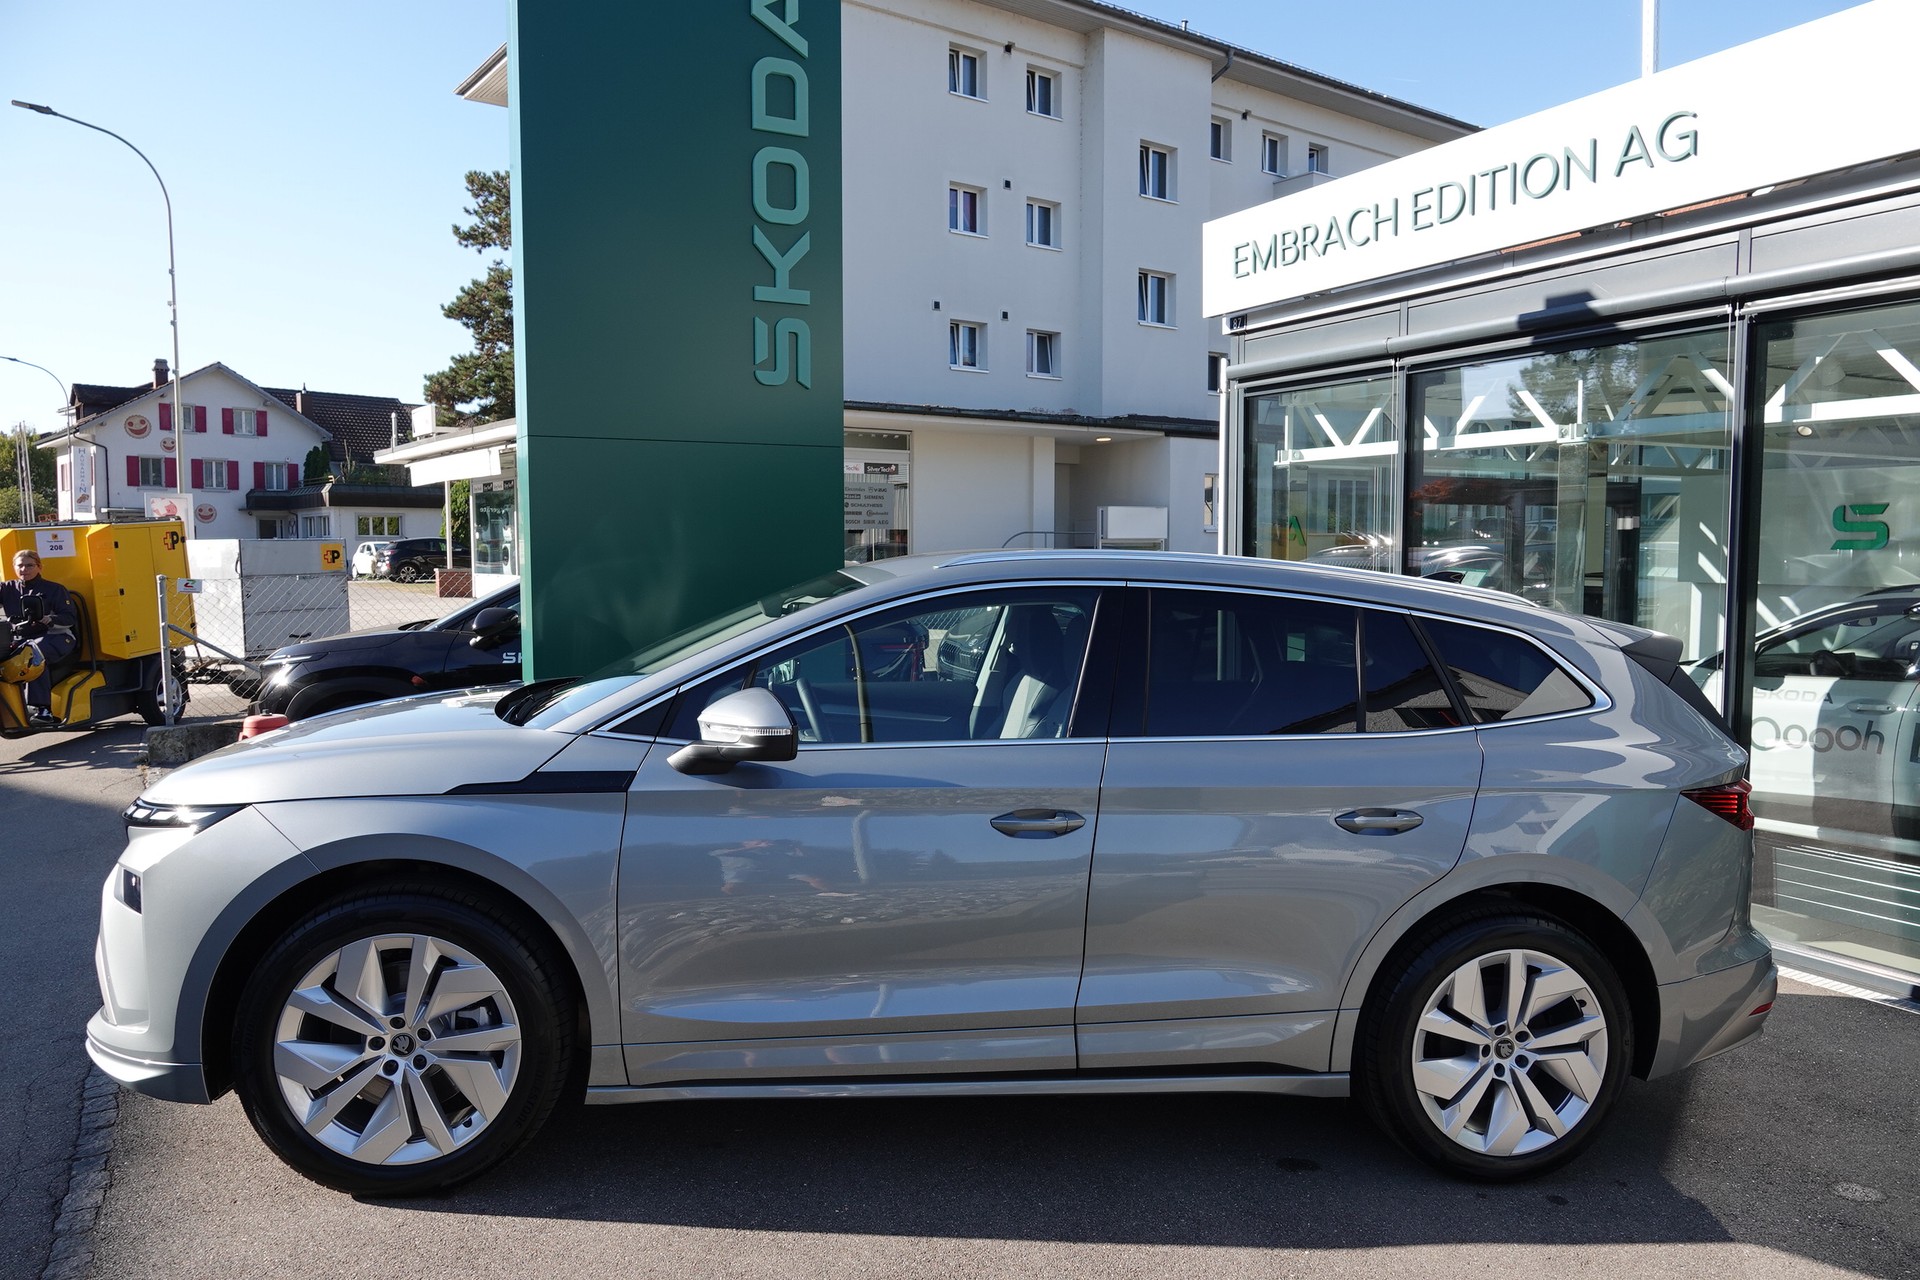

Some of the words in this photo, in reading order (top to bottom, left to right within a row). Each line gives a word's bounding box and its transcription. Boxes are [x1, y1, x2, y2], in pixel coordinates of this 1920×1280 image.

[1234, 197, 1398, 279] EMBRACH
[1411, 137, 1598, 231] EDITION
[1613, 110, 1699, 178] AG
[1232, 317, 1242, 330] 87
